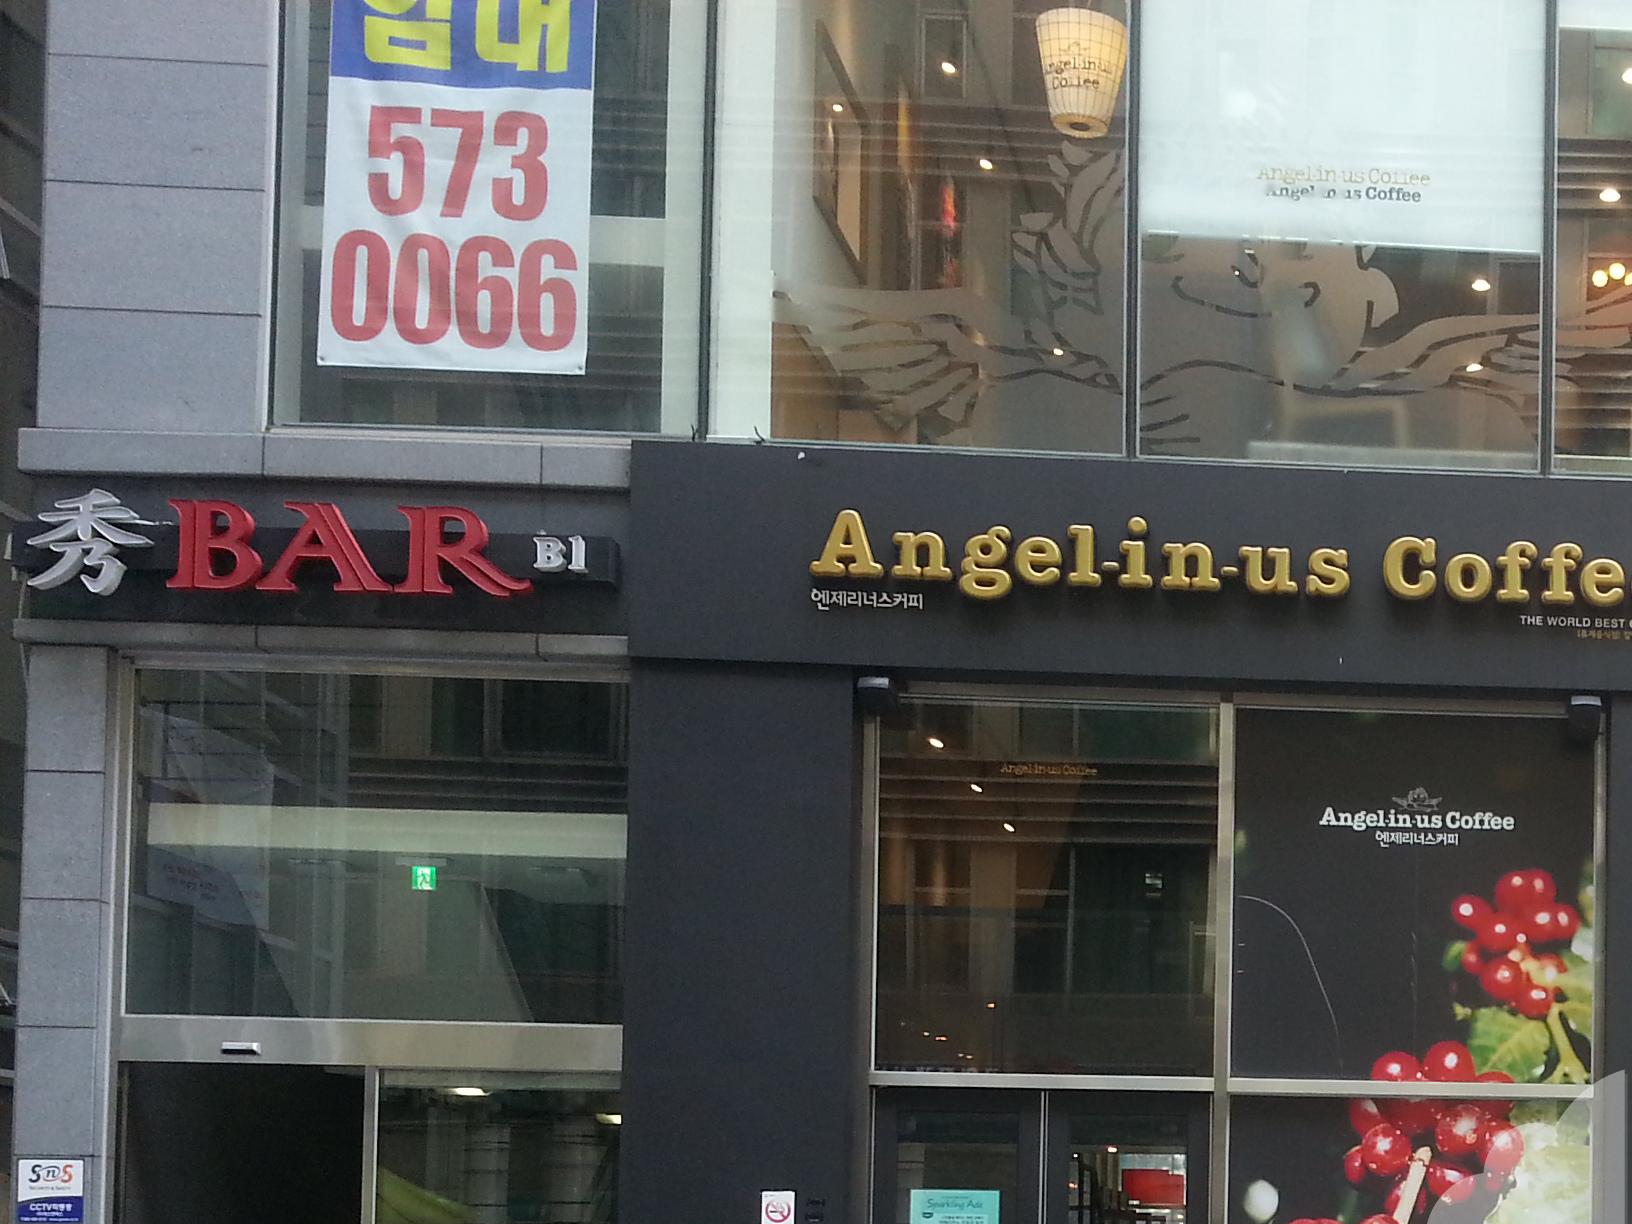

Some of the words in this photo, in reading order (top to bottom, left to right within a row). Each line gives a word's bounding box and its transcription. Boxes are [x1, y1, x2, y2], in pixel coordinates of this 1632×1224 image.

[366, 105, 550, 222] 573
[1368, 168, 1431, 186] Coffee
[1365, 186, 1422, 203] Coffee
[329, 229, 577, 352] 0066
[27, 488, 155, 597] 秀
[165, 499, 533, 597] BAR
[532, 533, 589, 574] B1
[809, 508, 1351, 600] Angel-in-us
[810, 588, 923, 611] 엔제리너스커피
[1520, 615, 1543, 626] THE
[1547, 616, 1591, 628] WORLD
[1595, 617, 1625, 629] BEST
[1319, 806, 1443, 831] Angel-in-us
[1445, 811, 1515, 830] Coffee
[1375, 831, 1459, 847] 엔제리너스커피
